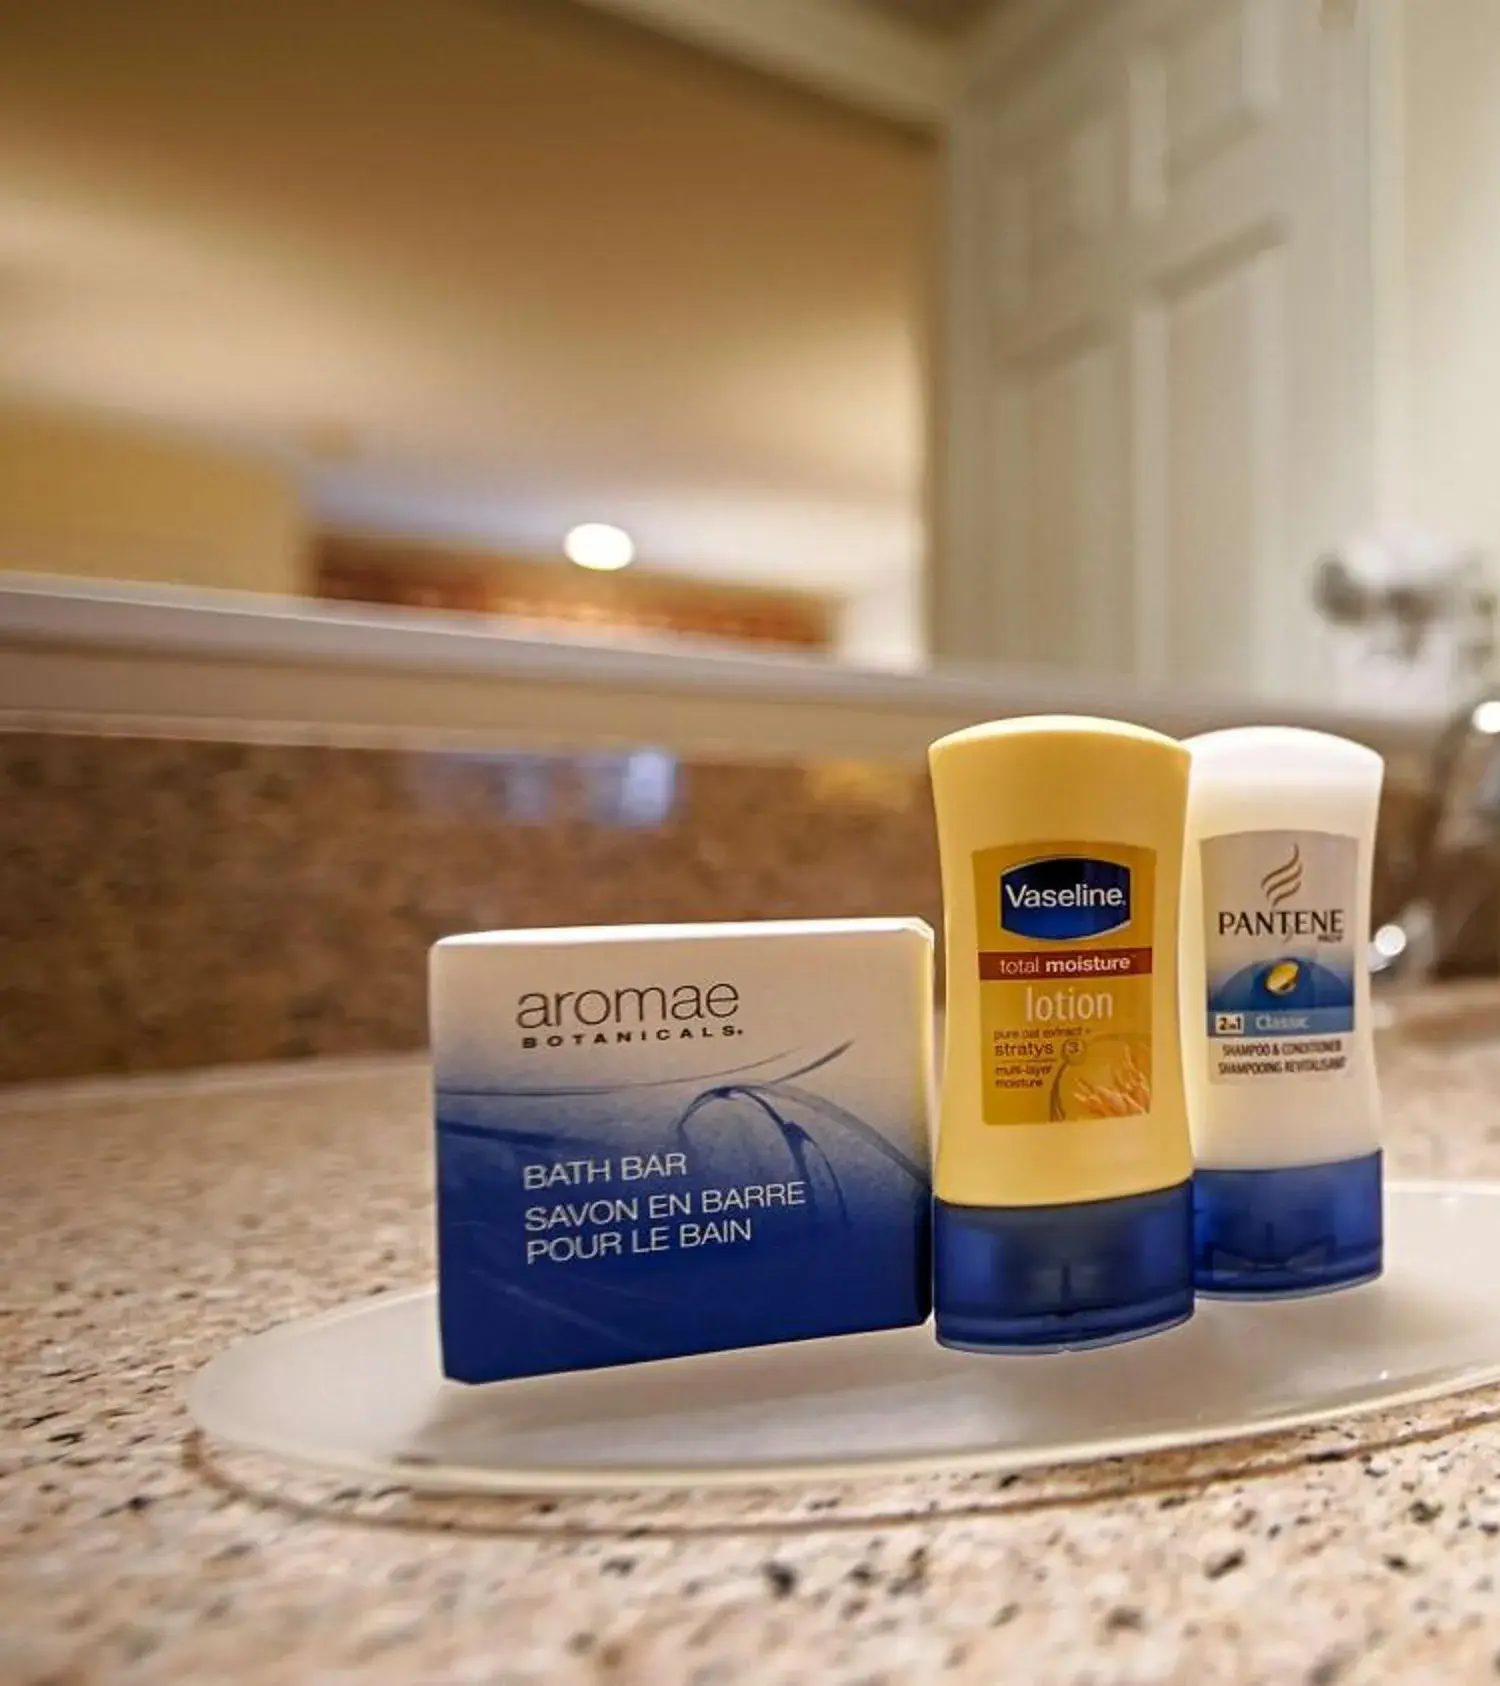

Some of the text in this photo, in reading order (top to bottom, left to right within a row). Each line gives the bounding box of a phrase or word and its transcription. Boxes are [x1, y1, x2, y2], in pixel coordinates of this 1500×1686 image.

[1004, 883, 1123, 908] Vaseline
[1218, 909, 1344, 936] PANTENE
[1000, 956, 1131, 974] total moisture
[516, 983, 739, 1029] aromae
[1025, 984, 1114, 1022] lotion
[1222, 1043, 1271, 1056] SHAMPOO
[1281, 1039, 1342, 1054] CONDITIONER
[1218, 1060, 1282, 1075] SHAMPOOING
[523, 1152, 688, 1189] BATH BAR
[525, 1181, 807, 1231] SAVON EN BARRE
[527, 1218, 752, 1264] POUR LE BAIN
